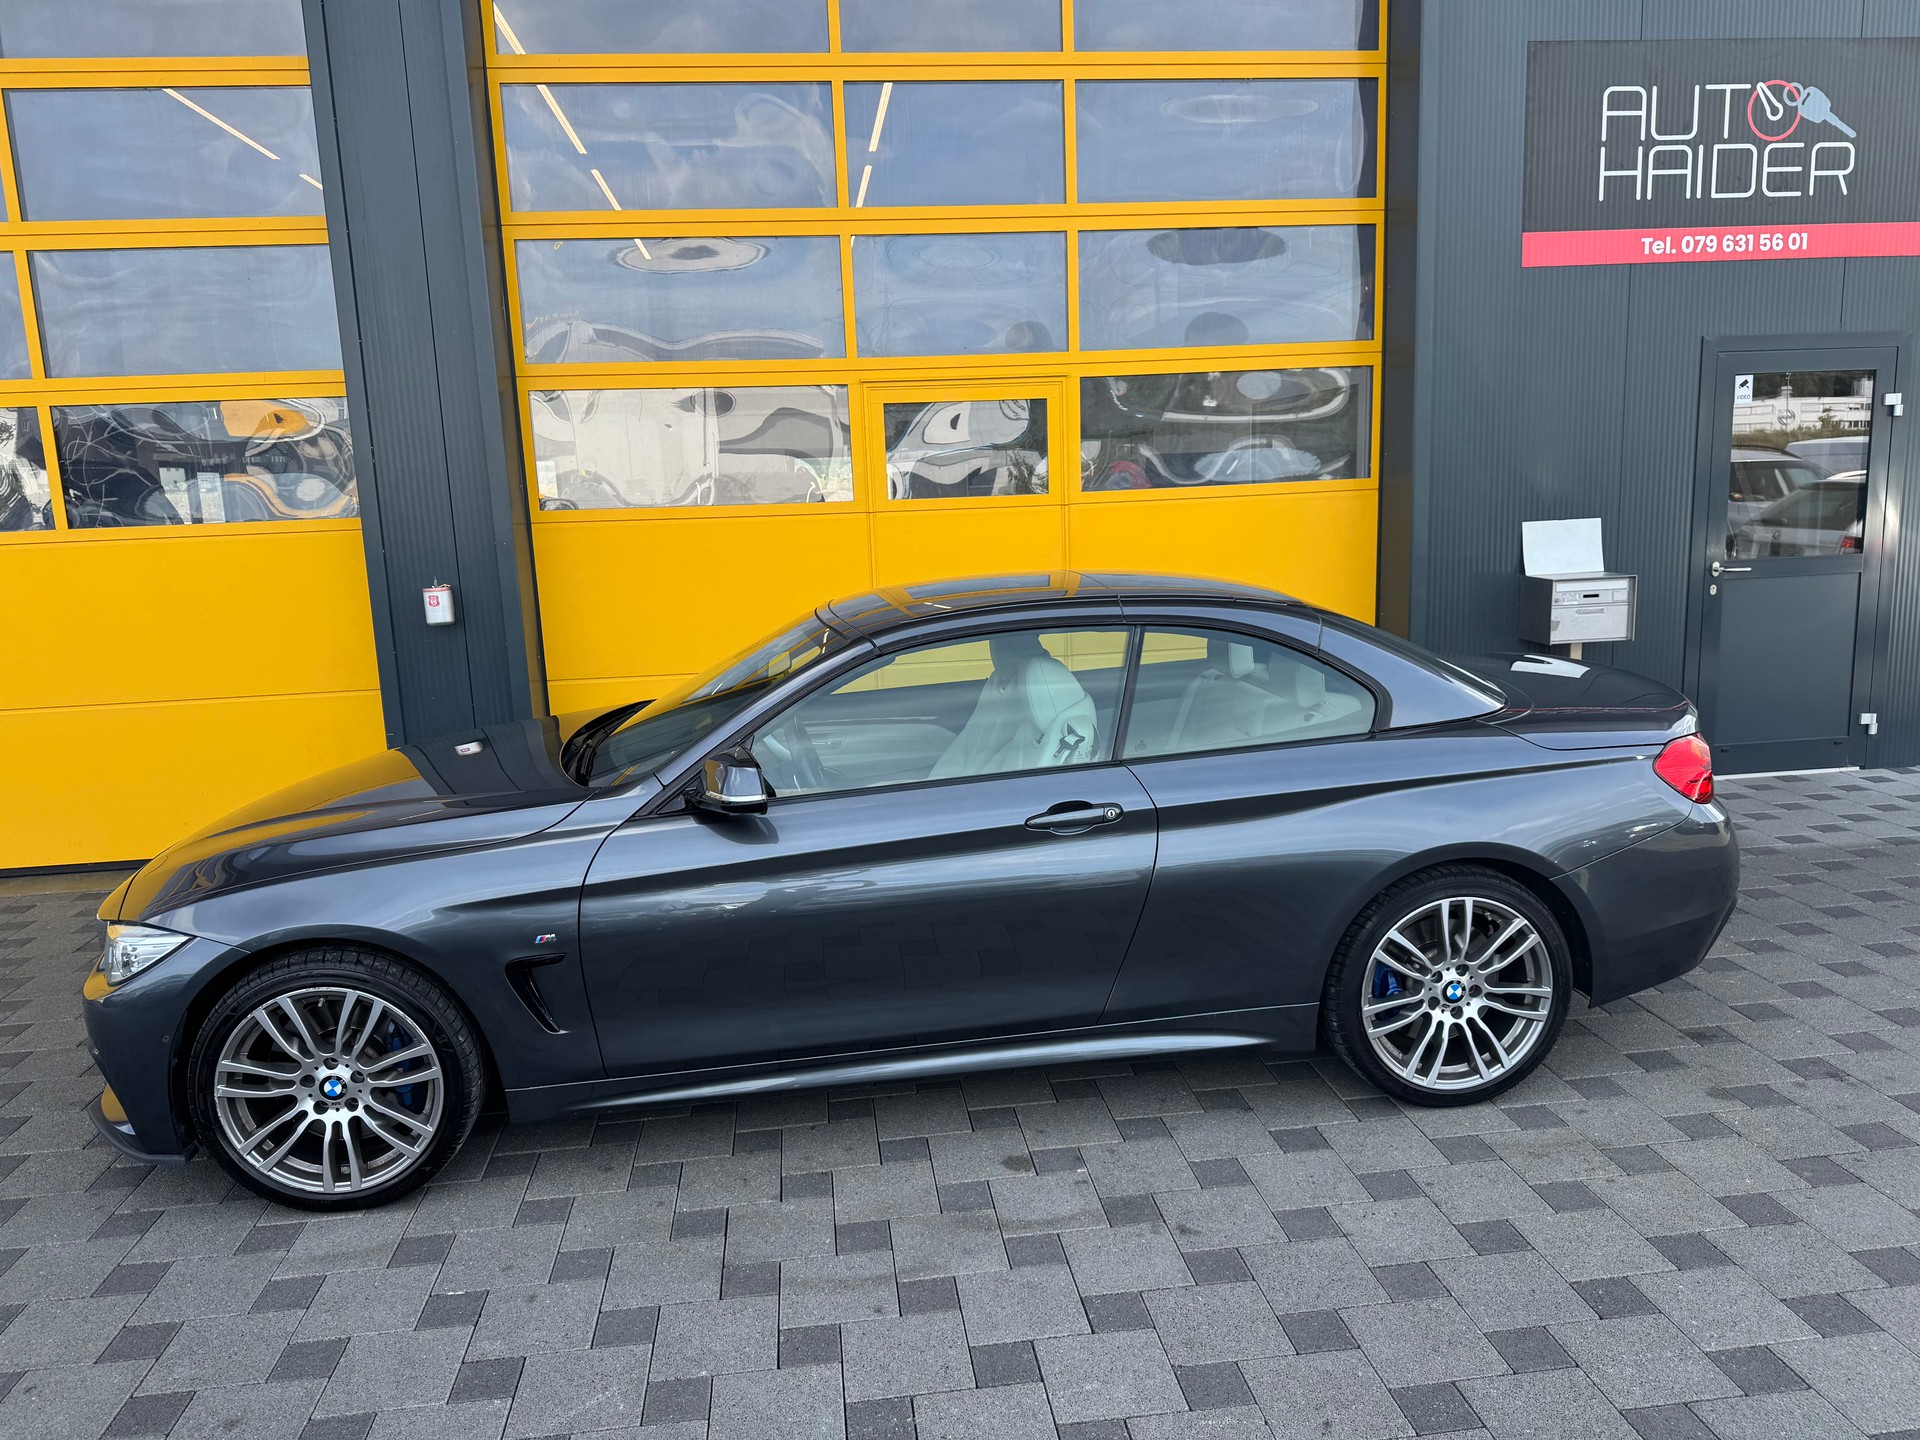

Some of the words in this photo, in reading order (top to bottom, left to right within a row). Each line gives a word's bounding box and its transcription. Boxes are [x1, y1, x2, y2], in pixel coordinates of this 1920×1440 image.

[1599, 141, 1855, 201] HAIDER
[1641, 236, 1677, 255] Tel.
[1681, 235, 1718, 254] 079
[1722, 234, 1754, 252] 631
[1759, 233, 1784, 251] 56
[1788, 232, 1808, 250] 01
